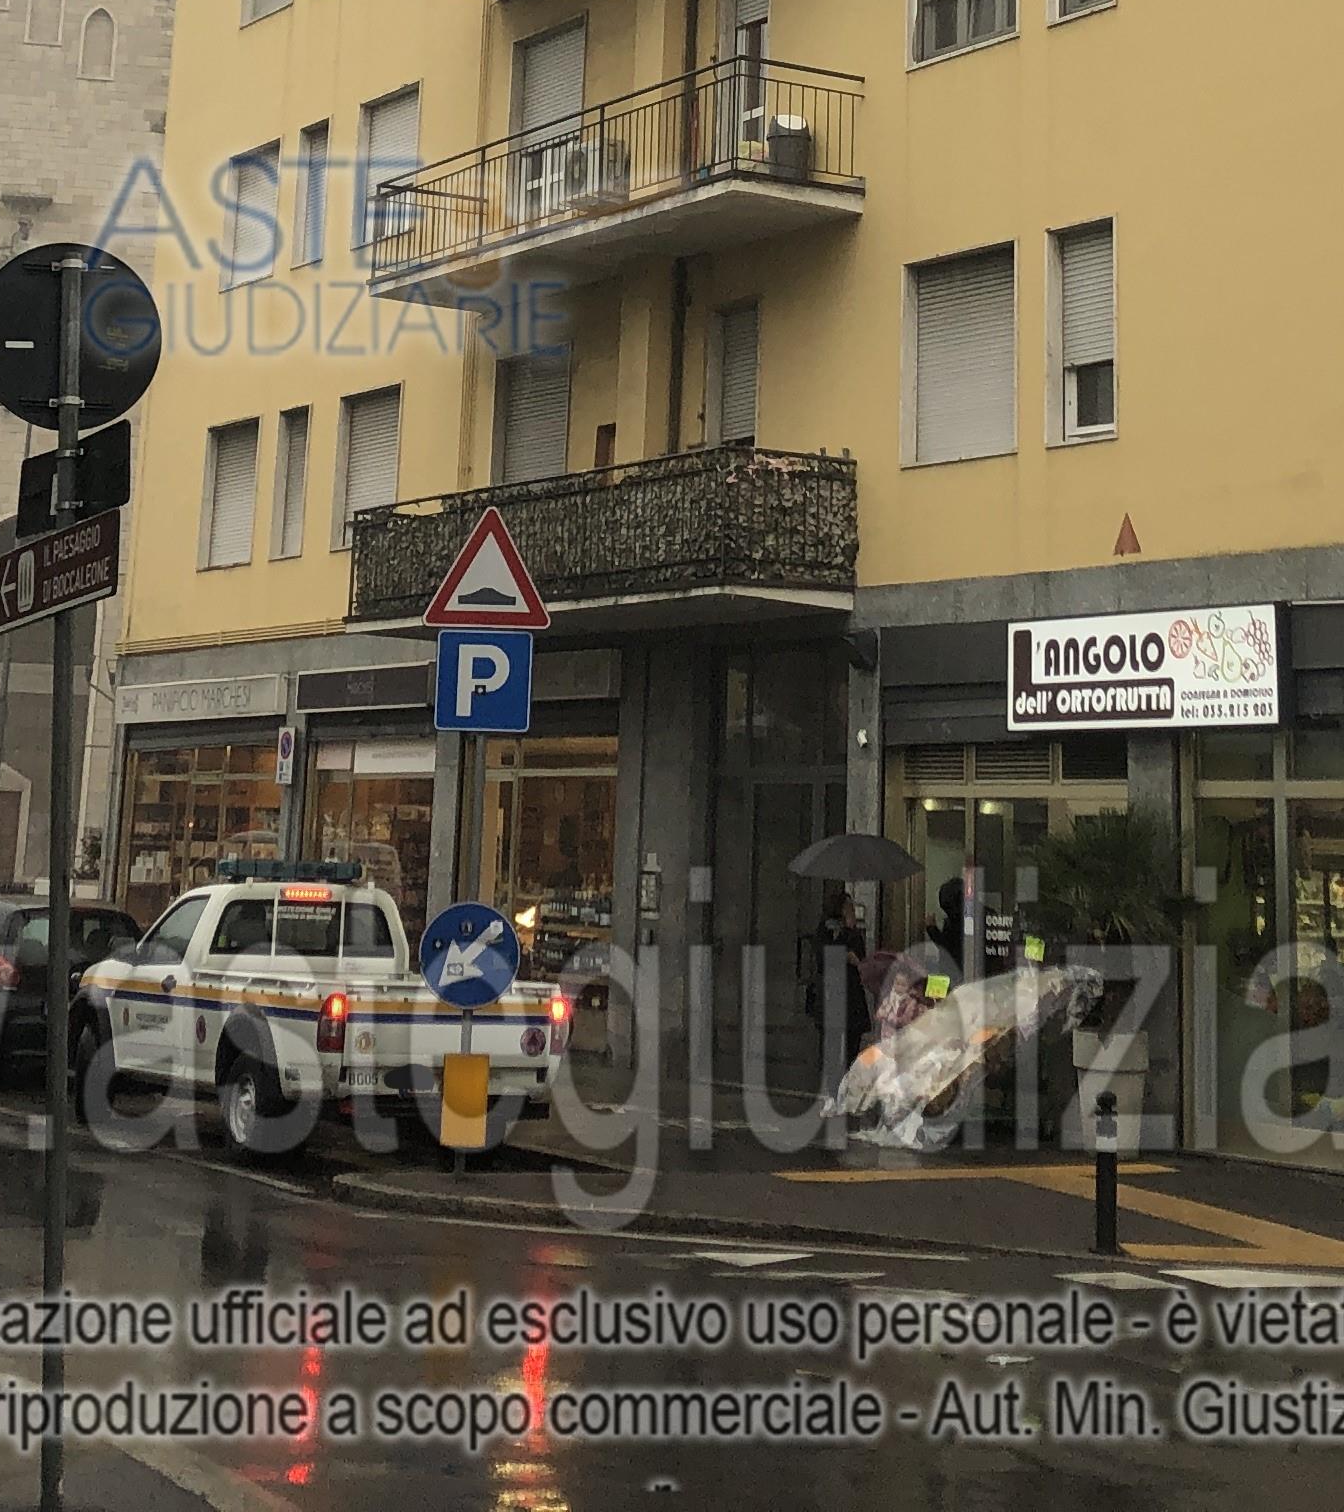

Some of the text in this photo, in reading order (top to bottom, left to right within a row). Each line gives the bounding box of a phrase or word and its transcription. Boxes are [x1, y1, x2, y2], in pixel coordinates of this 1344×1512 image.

[52, 523, 101, 564] PAESAGGIO
[52, 555, 110, 600] BOCCALEONE
[455, 643, 511, 717] P
[1015, 685, 1171, 715] dell' ORTOFRUTTA
[1181, 704, 1199, 719] tel:
